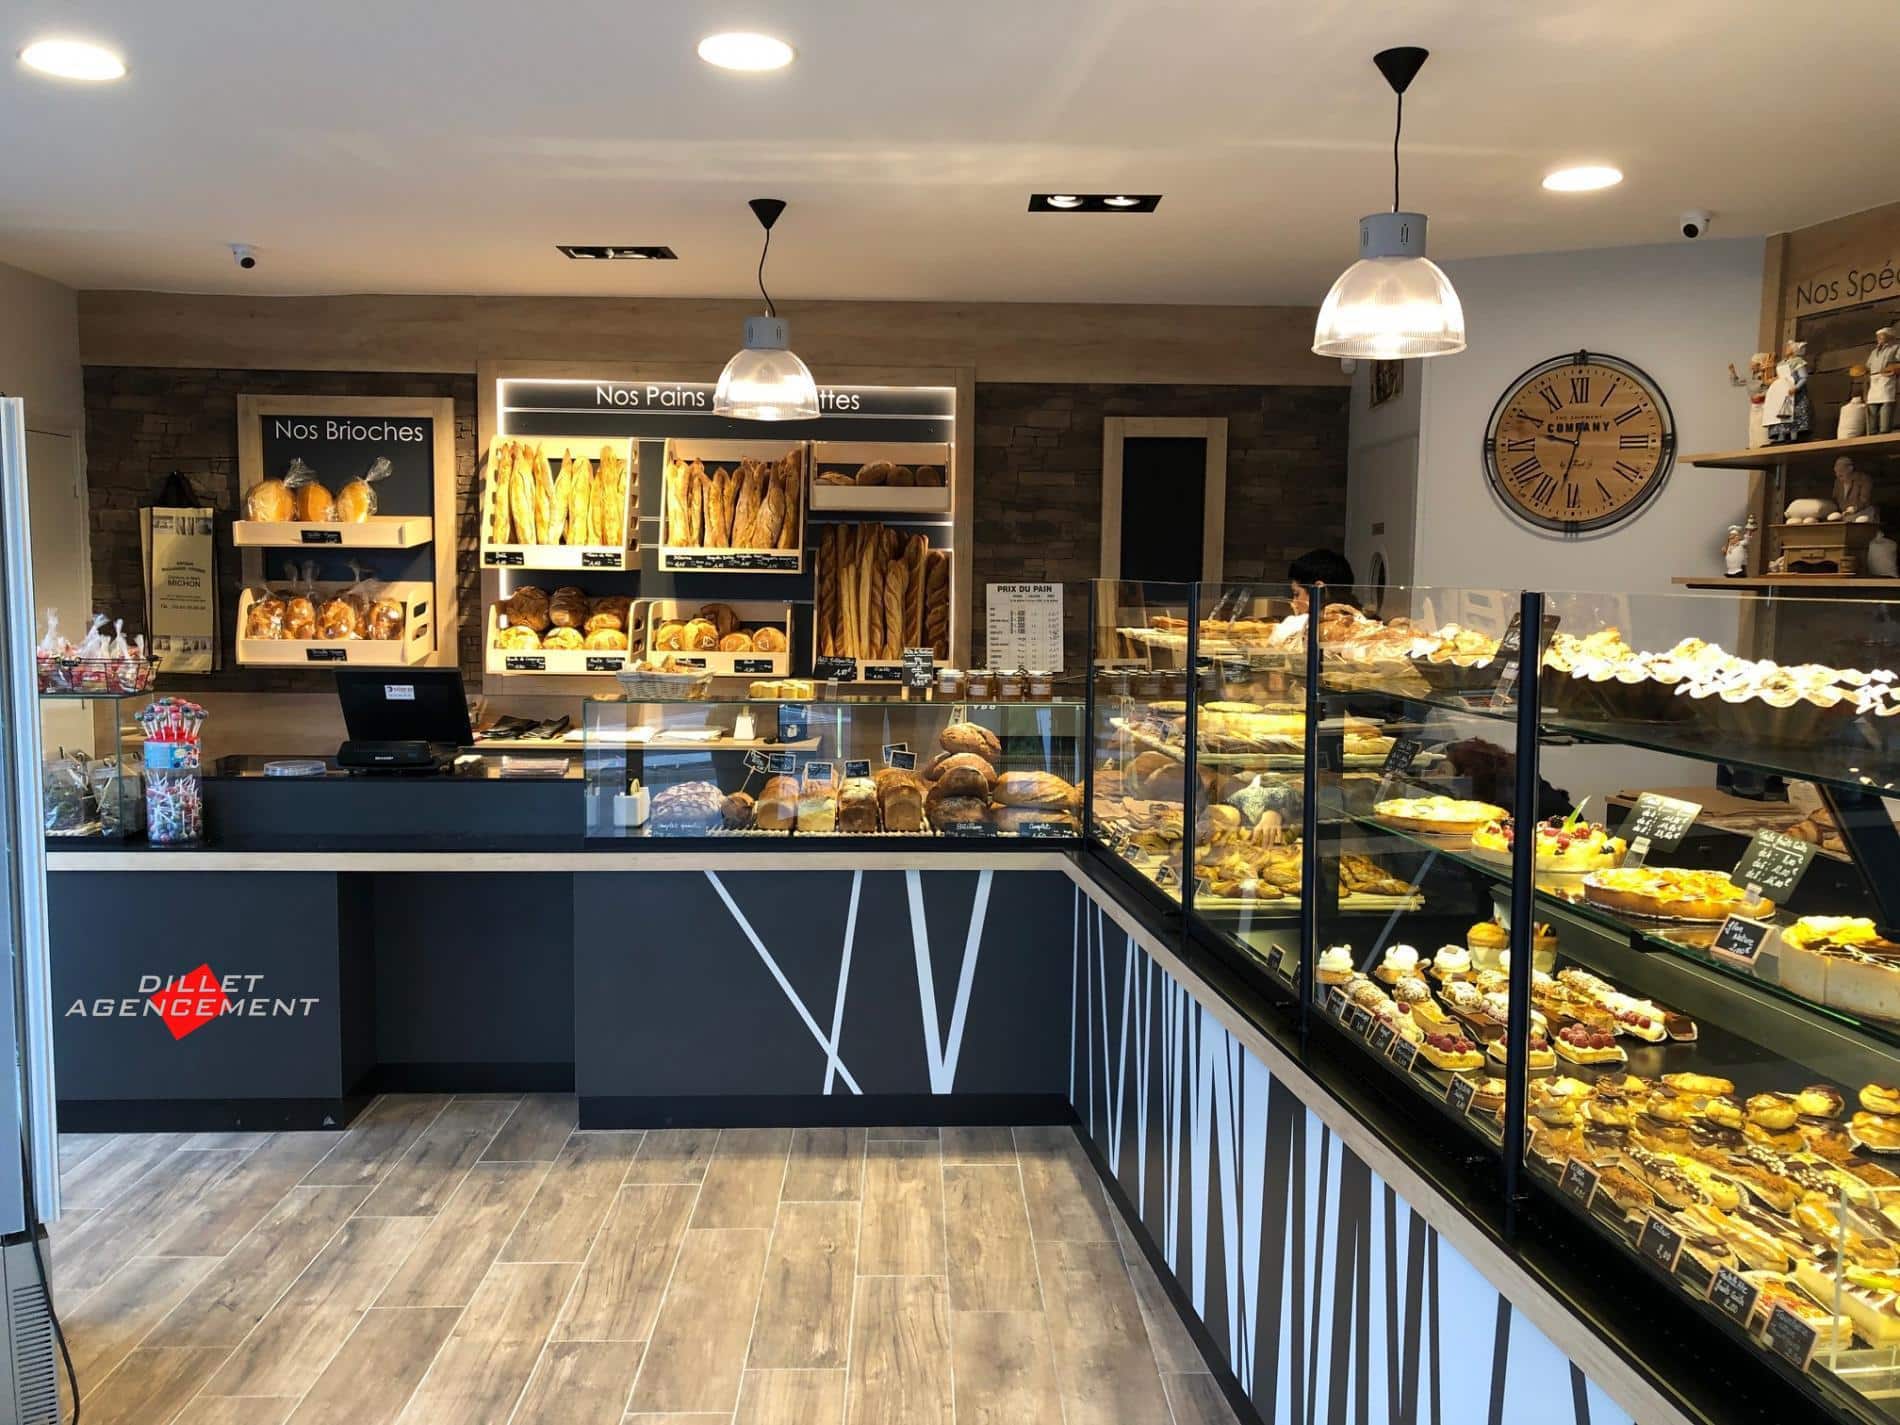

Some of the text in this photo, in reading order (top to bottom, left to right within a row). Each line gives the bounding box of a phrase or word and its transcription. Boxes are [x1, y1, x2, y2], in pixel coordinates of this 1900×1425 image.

[1797, 259, 1900, 310] Nos Spé
[596, 386, 639, 406] Nos
[646, 386, 705, 407] Pains
[1569, 377, 1590, 404] XII
[275, 420, 424, 442] Nos Brioches
[1547, 420, 1610, 433] COMPANY
[997, 585, 1053, 593] PRIX DU PAIN
[138, 974, 264, 993] DILLET
[65, 998, 320, 1017] AGENCEMENT
